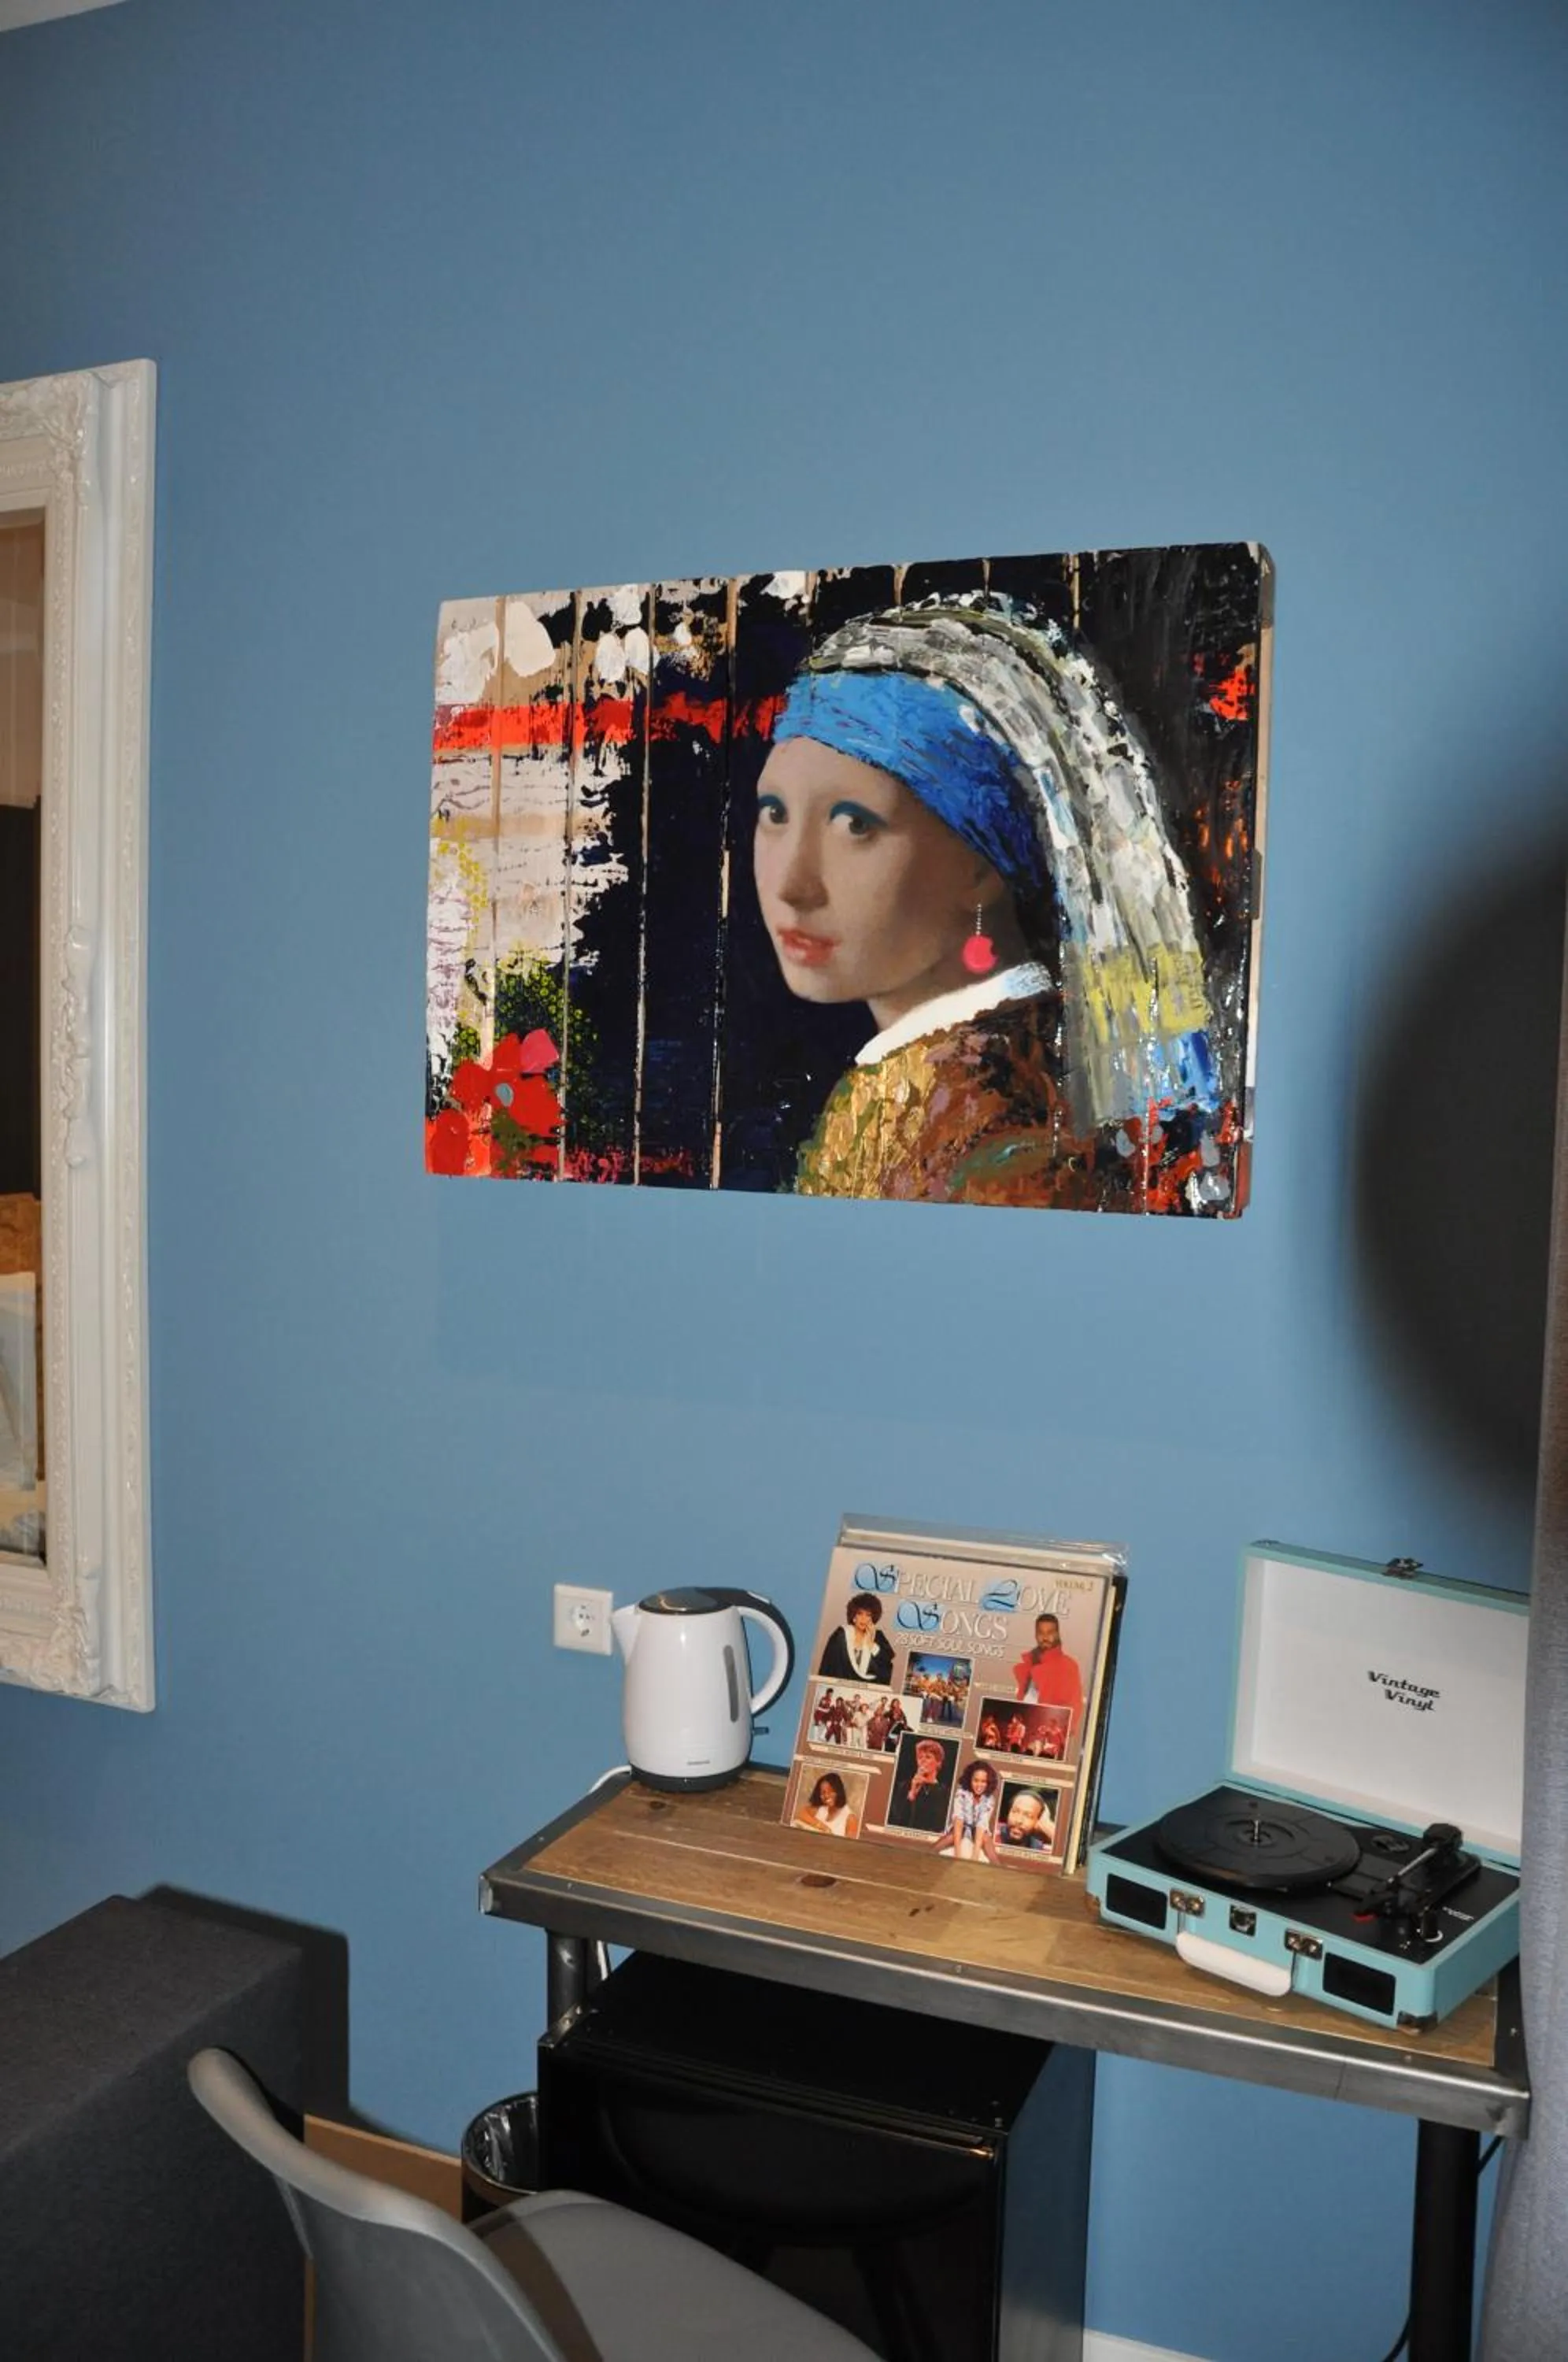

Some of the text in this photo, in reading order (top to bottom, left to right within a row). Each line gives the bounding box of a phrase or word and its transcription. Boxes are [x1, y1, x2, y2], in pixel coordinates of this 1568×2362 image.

[853, 1561, 1072, 1616] SPECIAL LOVE
[897, 1601, 1008, 1642] SONGS
[1367, 1670, 1440, 1698] Vintage
[1385, 1689, 1435, 1712] Vinyl
